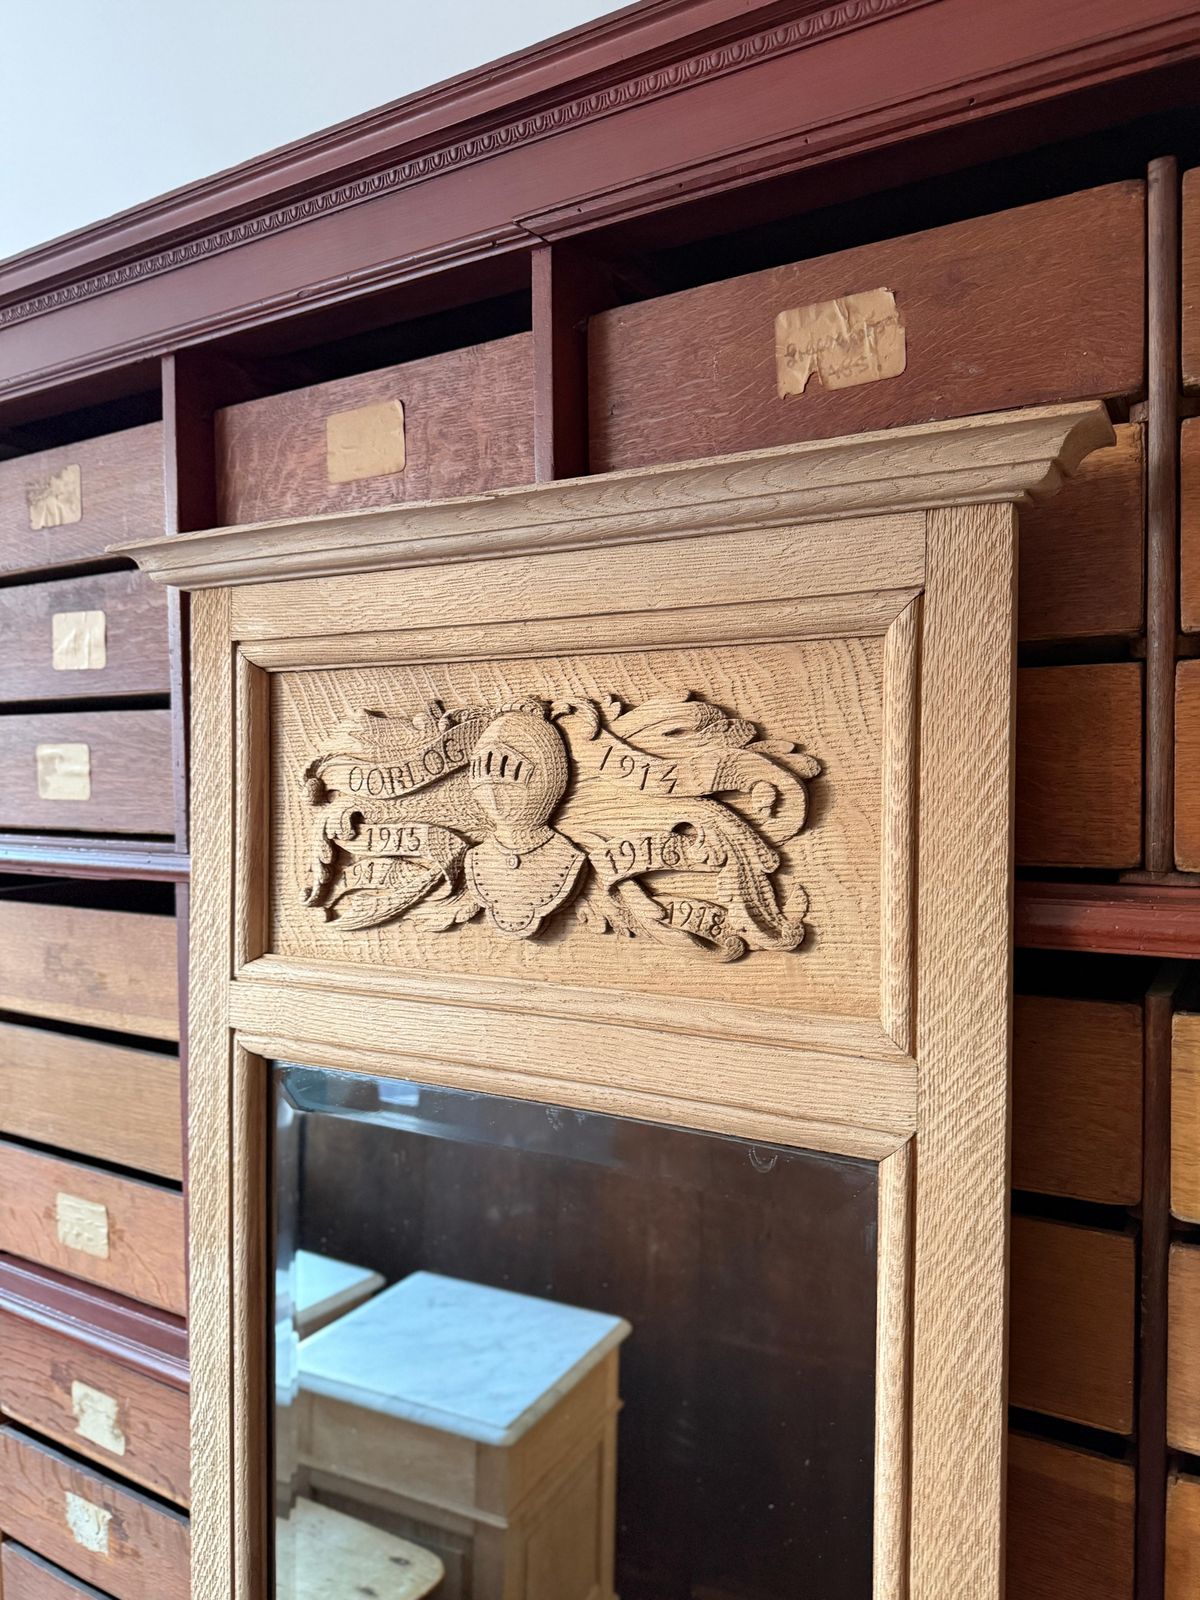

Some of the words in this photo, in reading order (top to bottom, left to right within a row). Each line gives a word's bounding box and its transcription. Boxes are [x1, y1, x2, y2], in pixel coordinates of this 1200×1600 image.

[350, 739, 464, 795] OORLOG
[600, 745, 677, 793] 1914
[366, 827, 420, 851] 1915
[605, 836, 680, 873] 1916
[342, 862, 393, 888] 1917
[666, 901, 725, 937] 1918
